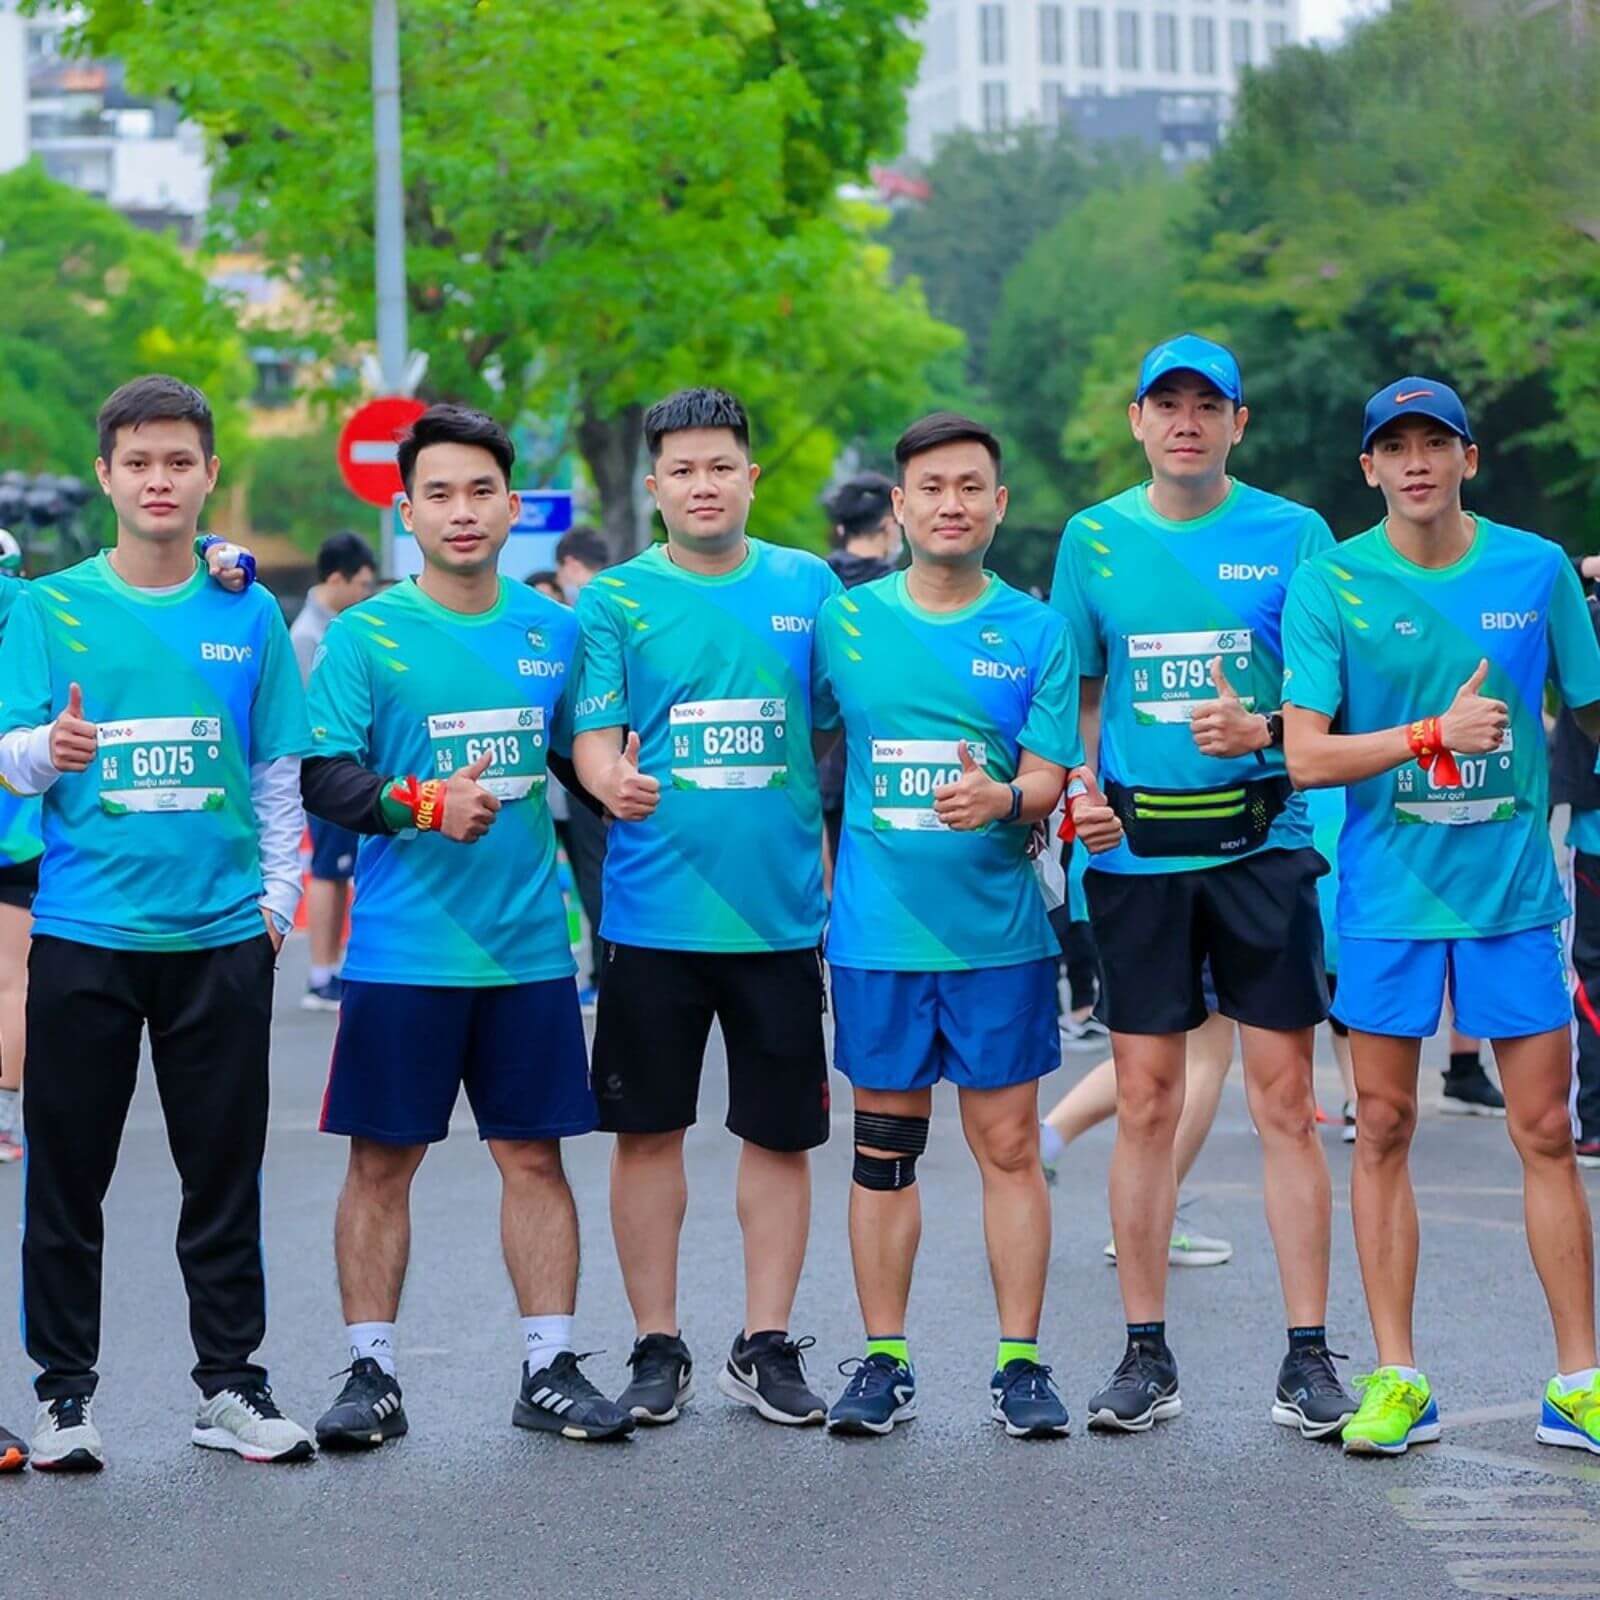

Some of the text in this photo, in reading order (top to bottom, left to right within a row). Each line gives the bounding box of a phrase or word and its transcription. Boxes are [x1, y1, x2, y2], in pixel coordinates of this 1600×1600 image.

[1218, 563, 1267, 581] BIDV
[770, 615, 812, 634] BIDV
[1481, 612, 1529, 629] BIDV
[1217, 633, 1236, 650] 65
[201, 642, 245, 663] BIDV
[518, 659, 558, 678] BIDV
[972, 659, 1019, 681] BIDV
[518, 710, 533, 727] 65
[760, 701, 777, 718] 65
[191, 719, 209, 737] 65
[703, 726, 764, 755] 6288
[132, 745, 195, 777] 6075
[1398, 769, 1413, 781] 6.5
[1398, 781, 1413, 792] KM
